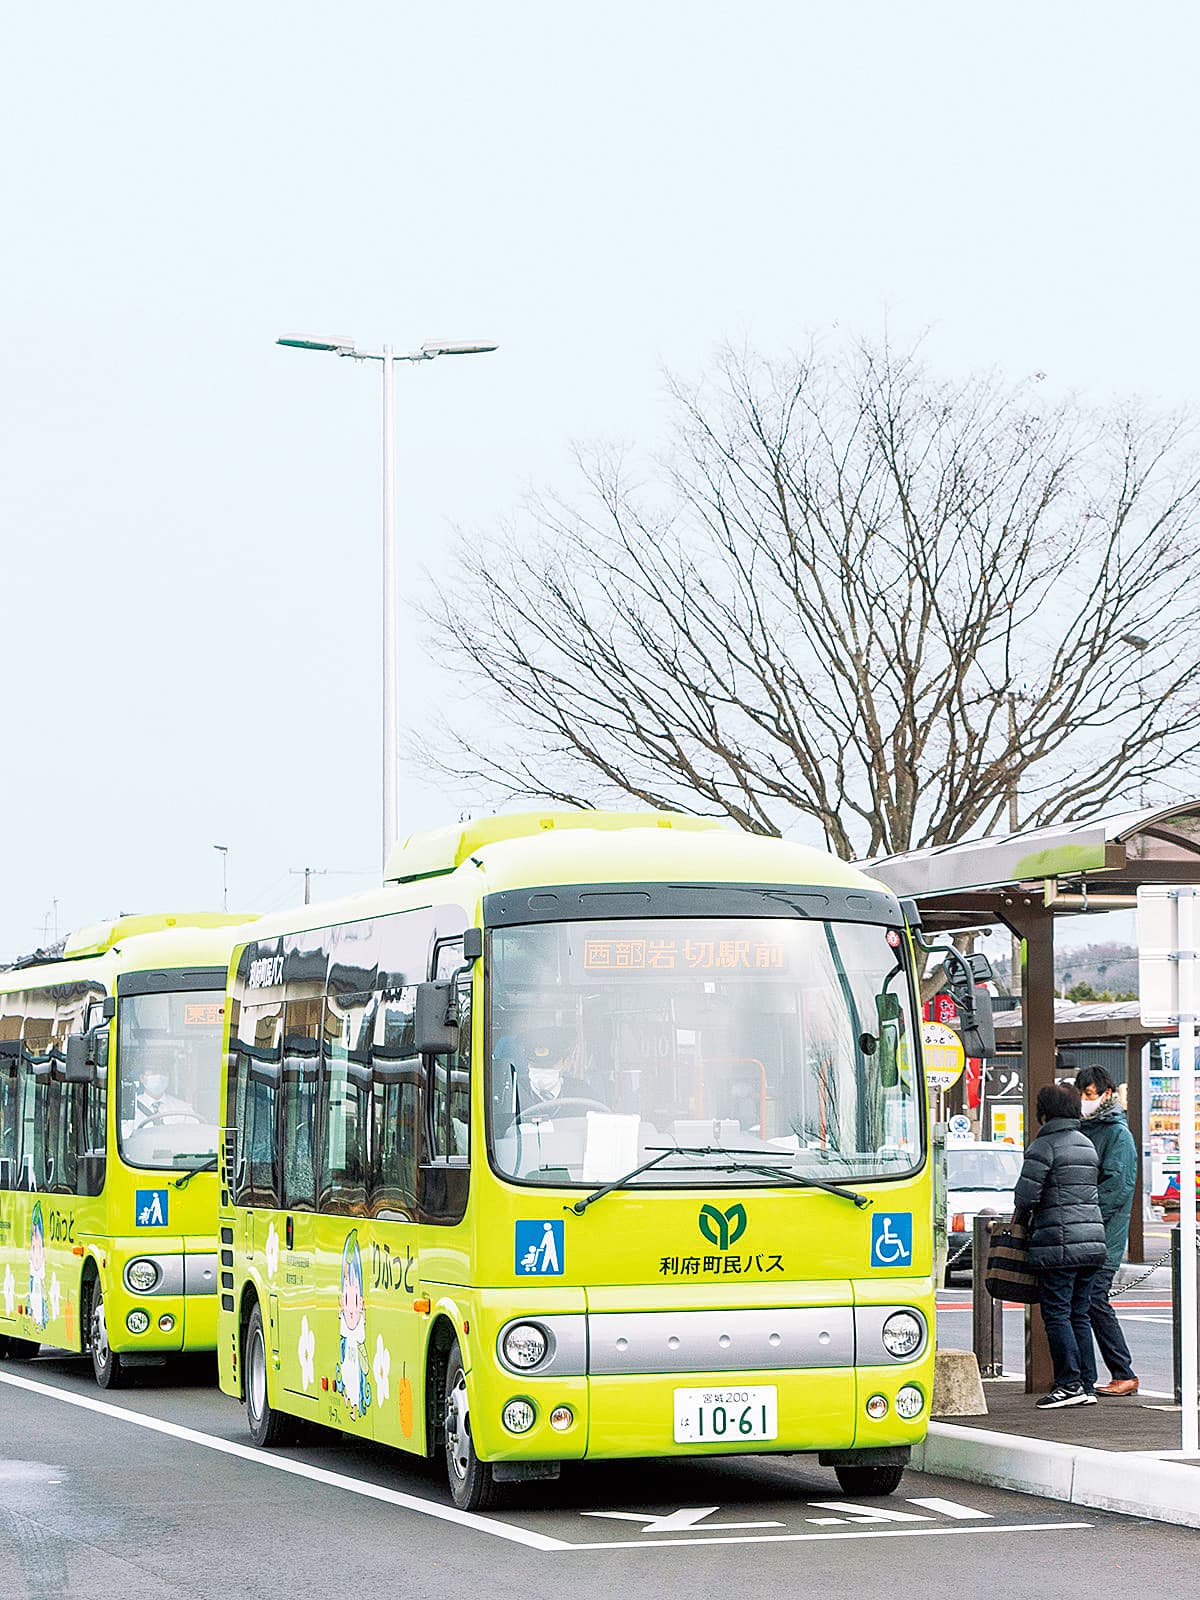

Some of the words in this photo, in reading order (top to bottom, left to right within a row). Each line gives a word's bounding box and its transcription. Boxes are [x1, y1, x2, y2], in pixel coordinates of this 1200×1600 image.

[372, 1240, 415, 1294] りふっと
[659, 1253, 785, 1276] 利府町民バス
[698, 1405, 767, 1436] 10-61
